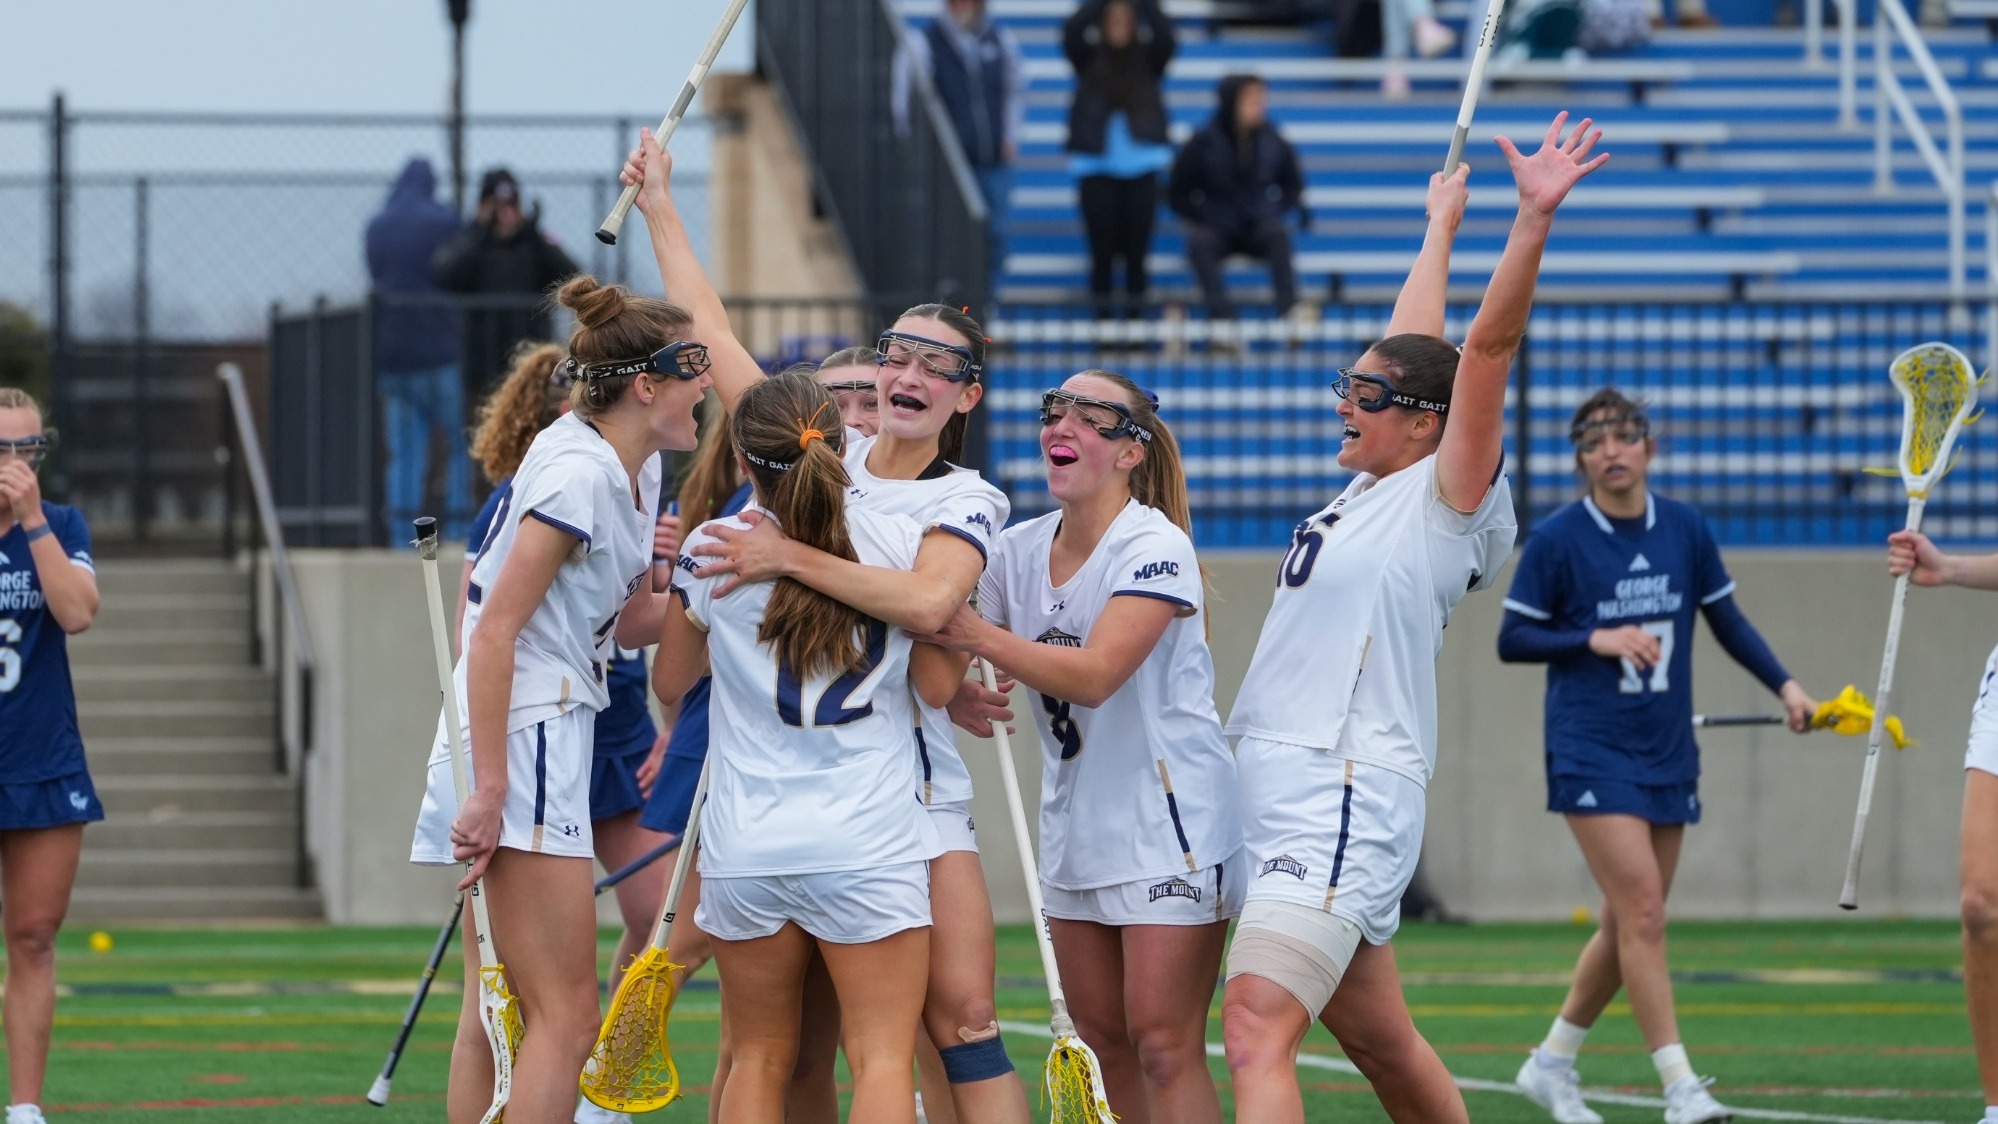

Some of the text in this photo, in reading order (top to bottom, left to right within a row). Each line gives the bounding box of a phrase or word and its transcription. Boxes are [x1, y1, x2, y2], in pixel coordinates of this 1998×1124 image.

[616, 362, 648, 375] GAIT
[1419, 400, 1447, 412] GAIT
[747, 452, 766, 466] GAIT
[0, 570, 32, 591] RGE
[1133, 560, 1179, 581] MAAC
[1615, 574, 1670, 600] GEORGE
[0, 590, 45, 610] NGTO
[1597, 591, 1683, 620] WASHINGTON
[757, 608, 888, 728] 12
[1040, 691, 1083, 761] 8
[1276, 860, 1307, 880] MOUNT
[1149, 884, 1201, 902] THE MOUNT
